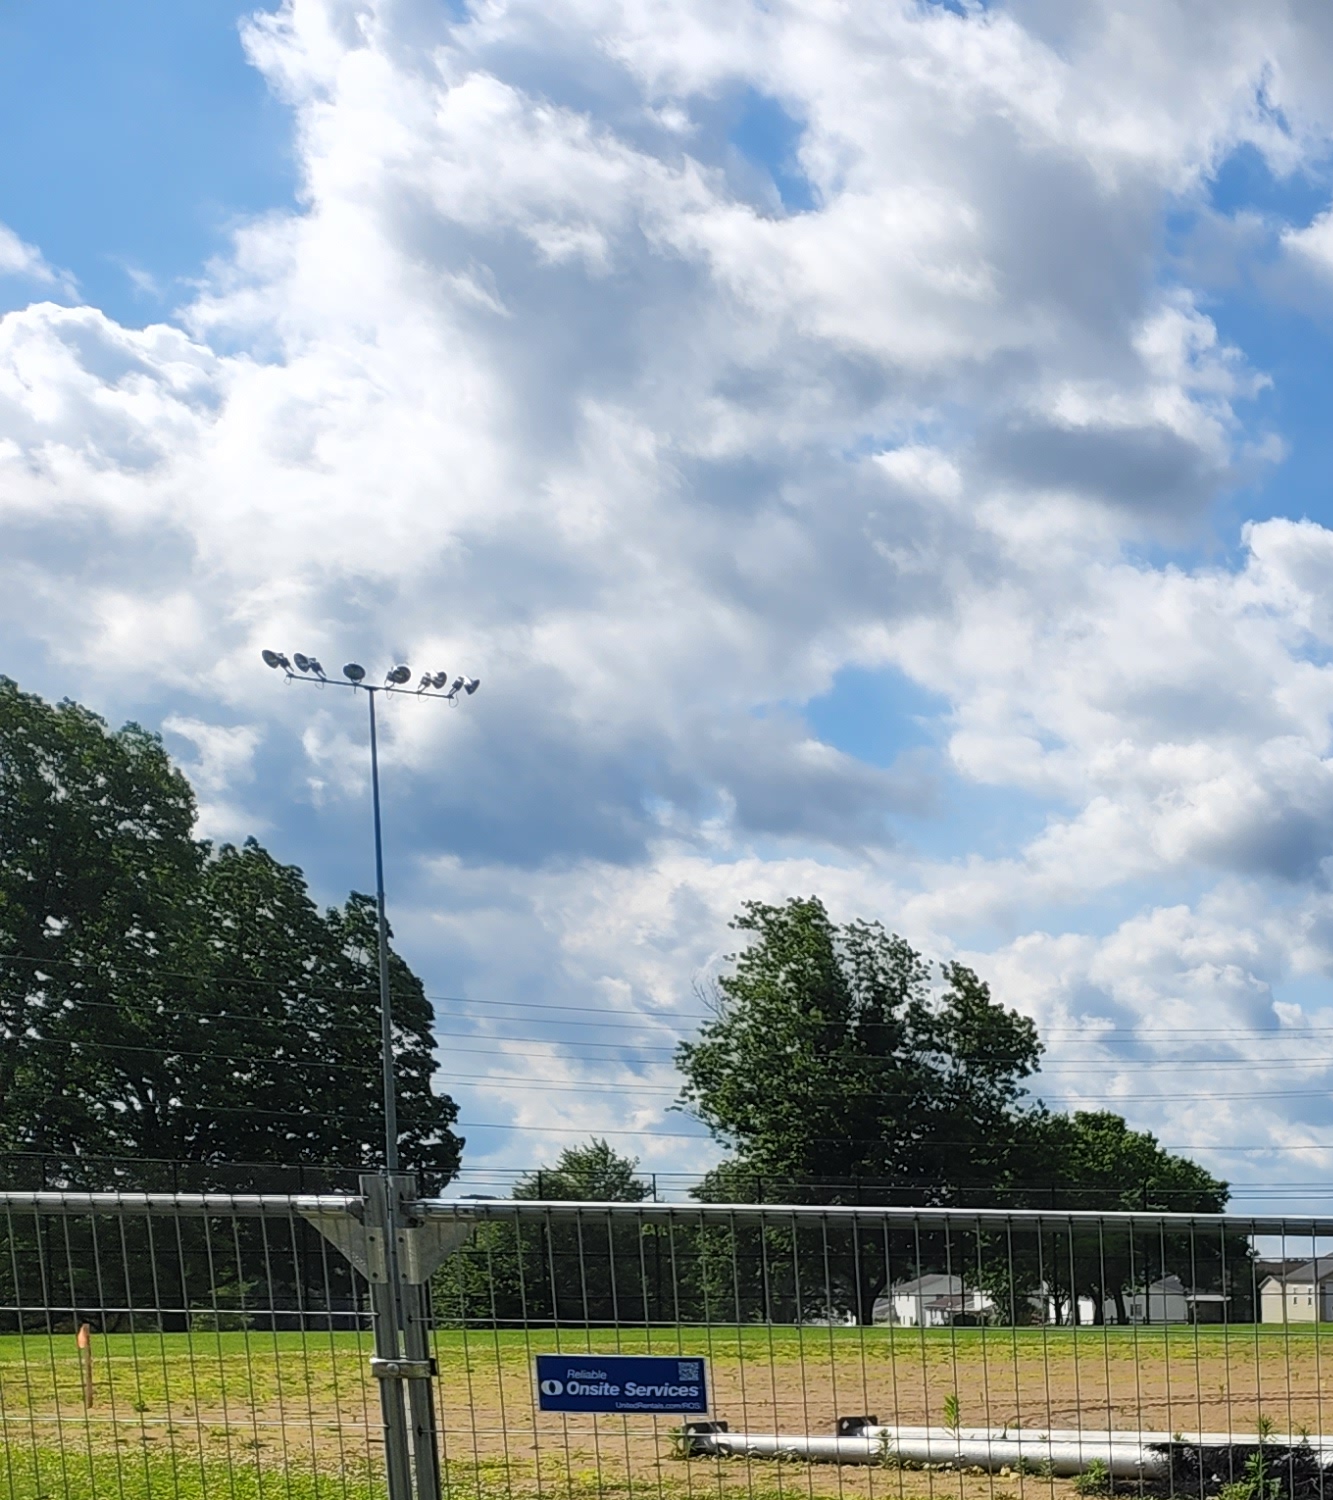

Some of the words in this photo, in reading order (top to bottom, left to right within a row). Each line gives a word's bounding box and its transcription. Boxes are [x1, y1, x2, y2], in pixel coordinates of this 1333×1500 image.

[566, 1369, 608, 1380] Reliable
[566, 1381, 620, 1396] Onsite
[624, 1382, 699, 1397] Services
